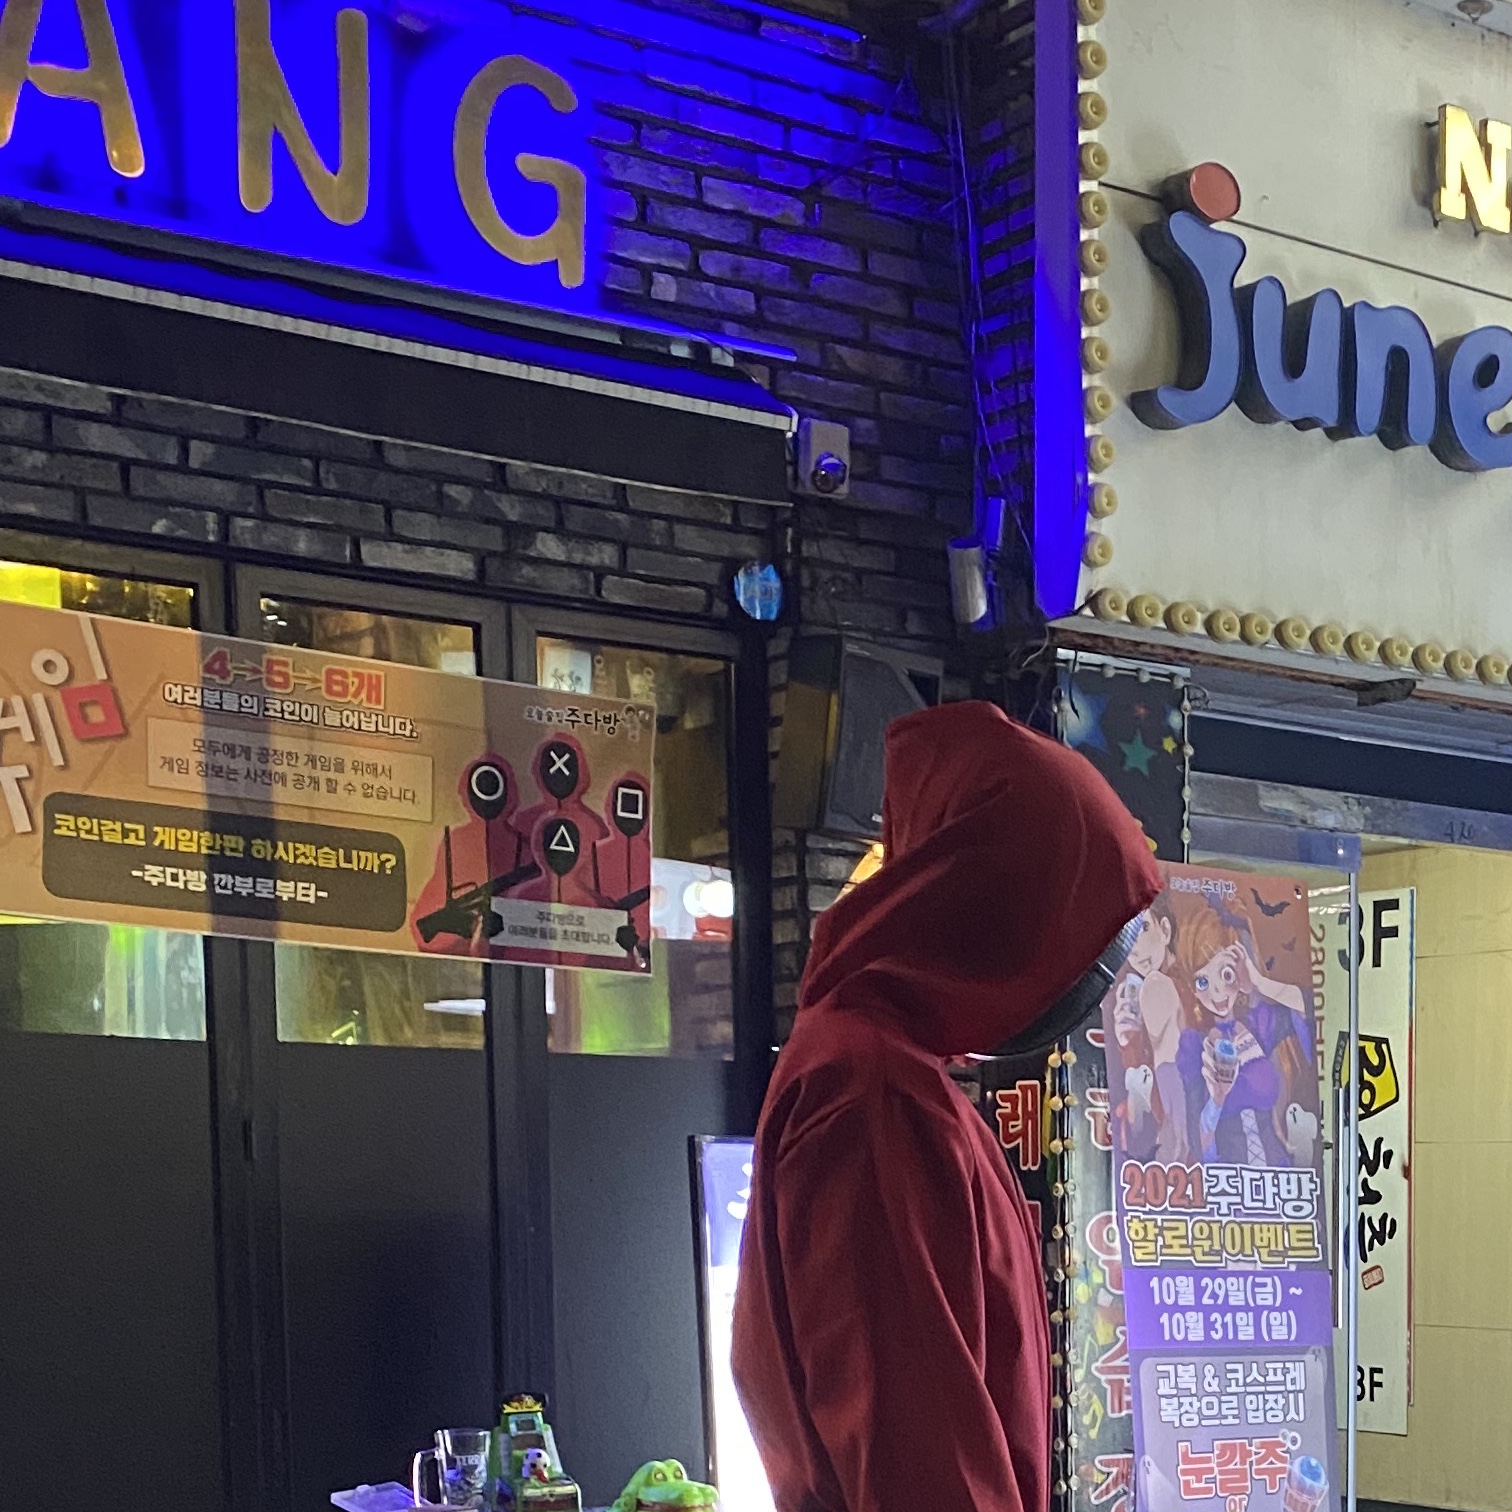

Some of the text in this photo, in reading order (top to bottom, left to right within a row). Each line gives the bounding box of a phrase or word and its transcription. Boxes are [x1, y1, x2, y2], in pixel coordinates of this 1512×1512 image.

[163, 682, 260, 715] 여러분들의
[263, 698, 320, 725] 코인이
[323, 666, 385, 708] 6개
[564, 707, 622, 736] 주다방
[160, 755, 190, 775] 게임
[195, 760, 240, 781] 정보는
[291, 774, 321, 792] 공개
[343, 781, 357, 797] 수
[192, 738, 252, 761] 모두에게
[303, 753, 346, 775] 게임을
[350, 761, 393, 780] 위해서
[53, 813, 147, 847] 코인걸고
[1337, 897, 1401, 974] 3F
[1150, 1276, 1195, 1306] 10월
[1200, 1276, 1282, 1307] 29일(금)
[1159, 1309, 1297, 1342] 10월 31일 (일)
[1156, 1360, 1306, 1395] 교복 & 코스프레
[1159, 1393, 1306, 1428] 복장으로 입장시
